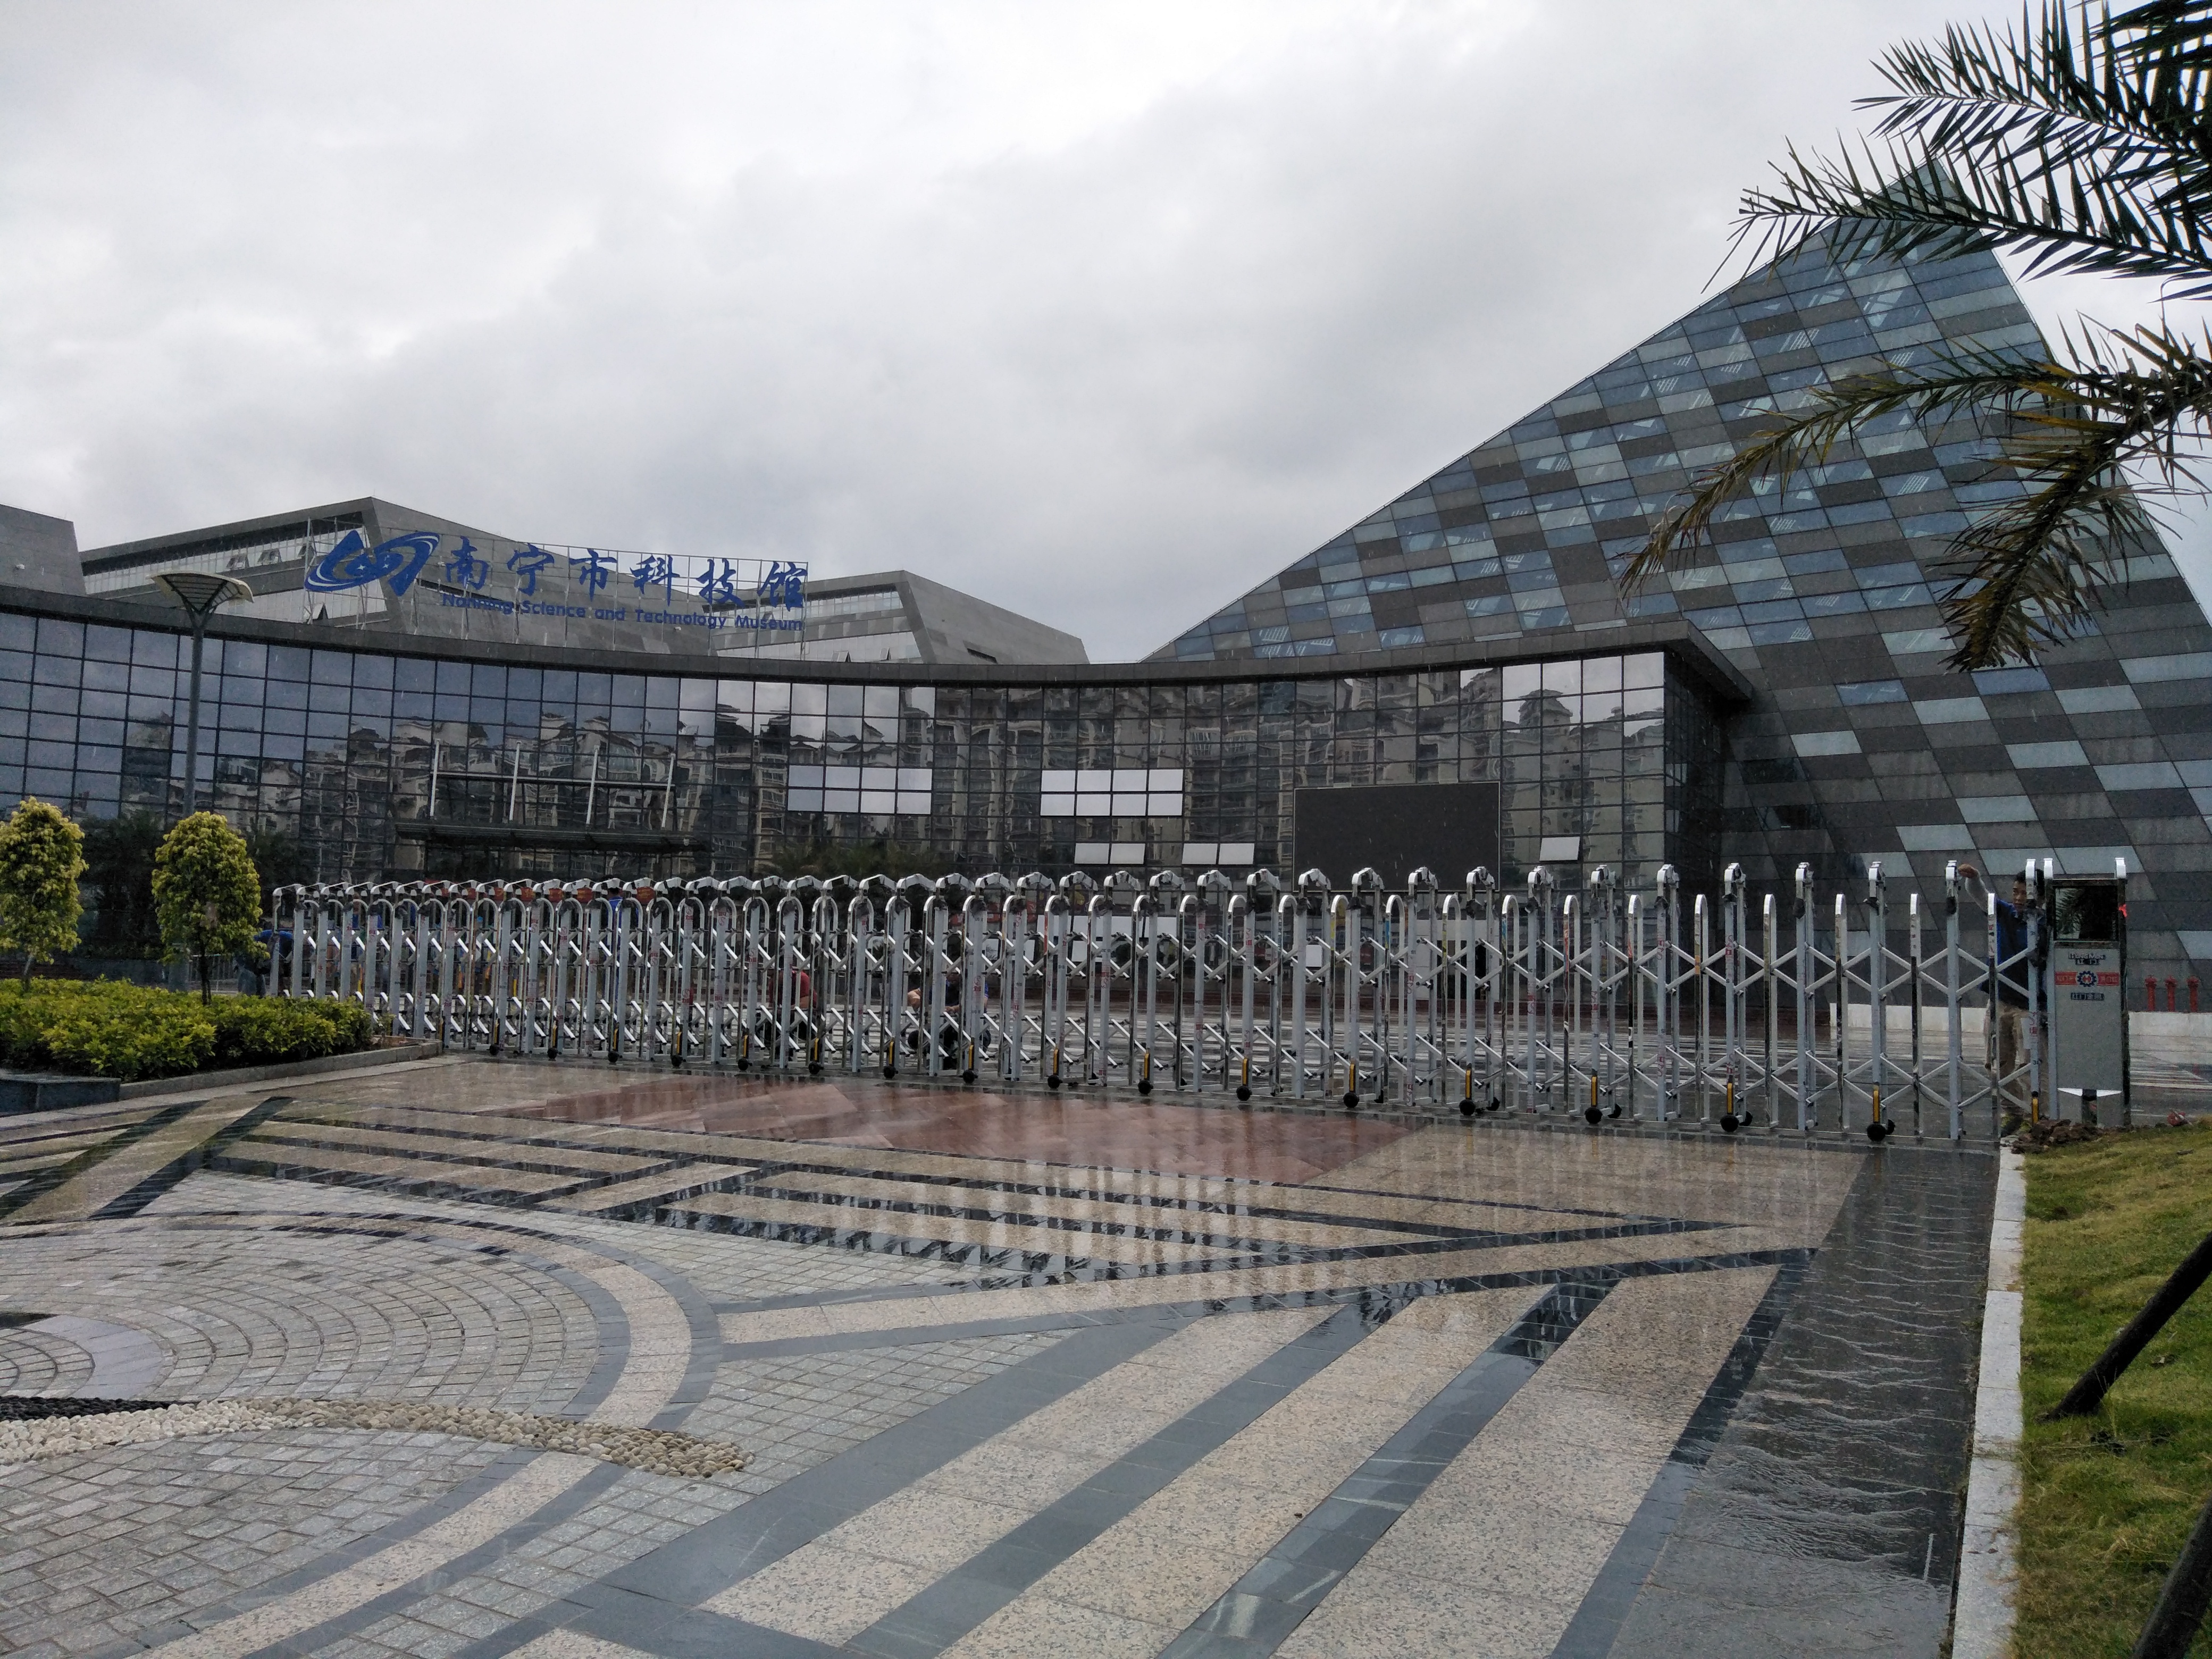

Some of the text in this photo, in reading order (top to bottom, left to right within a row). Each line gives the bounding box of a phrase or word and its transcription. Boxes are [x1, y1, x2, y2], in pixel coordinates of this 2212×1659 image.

[445, 536, 808, 611] 南宁市科技馆
[442, 593, 803, 632] Nanning Science and Technology Museum
